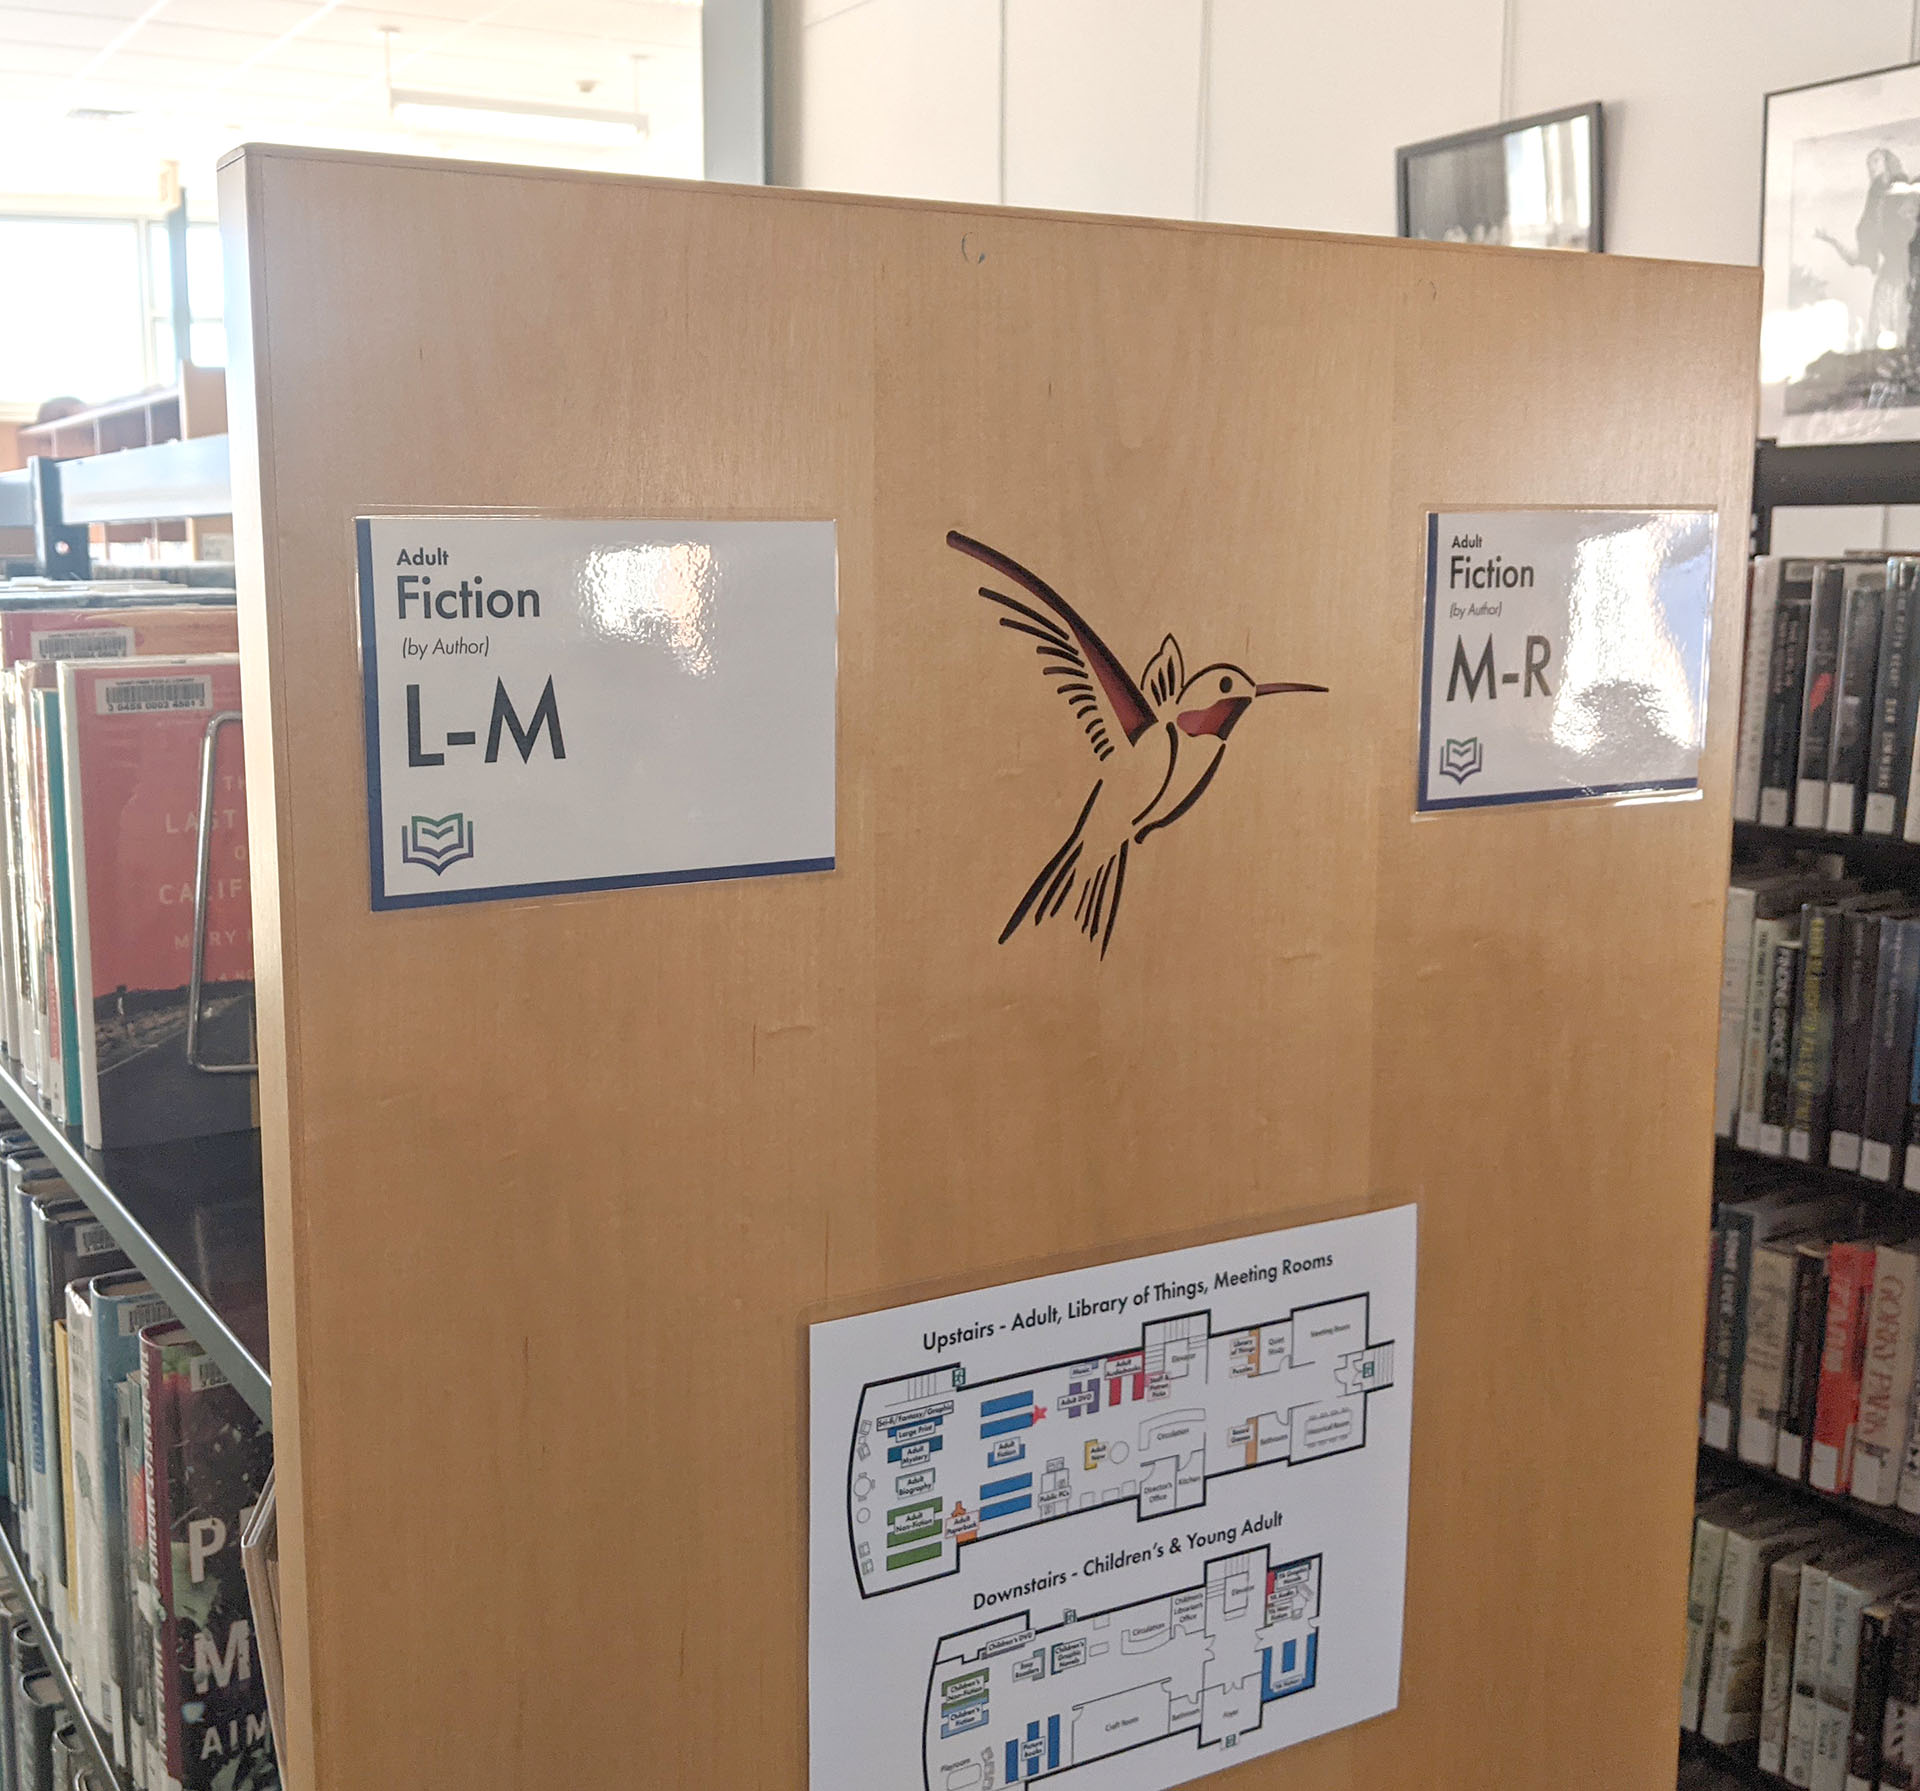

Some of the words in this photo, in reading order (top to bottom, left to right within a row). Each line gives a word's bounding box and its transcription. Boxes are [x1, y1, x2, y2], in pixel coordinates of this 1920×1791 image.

[1451, 533, 1483, 548] Adult
[396, 547, 449, 566] Adult
[1450, 555, 1534, 589] Fiction
[397, 574, 540, 619] Fiction
[1450, 602, 1465, 618] (by
[1468, 601, 1502, 617] Author)
[402, 637, 428, 658] (by
[432, 634, 490, 657] Author)
[1446, 632, 1552, 703] M-R
[406, 673, 566, 768] L-M
[159, 879, 242, 905] CAIF
[174, 930, 237, 949] MRY
[923, 1321, 994, 1353] Upstairs
[1011, 1304, 1062, 1332] Adult,
[1068, 1296, 1128, 1320] Library
[1133, 1285, 1150, 1306] of
[1153, 1280, 1208, 1302] Things,
[1214, 1265, 1278, 1290] Meeting
[1282, 1253, 1333, 1275] Rooms
[907, 1445, 924, 1455] Adult
[907, 1475, 924, 1486] Adult
[905, 1512, 923, 1522] Adult
[953, 1515, 970, 1525] Adult
[973, 1570, 1067, 1610] Downstairs
[1083, 1542, 1164, 1577] Children's
[1169, 1539, 1182, 1553] &
[1186, 1525, 1237, 1550] Young
[1241, 1511, 1283, 1537] Adult
